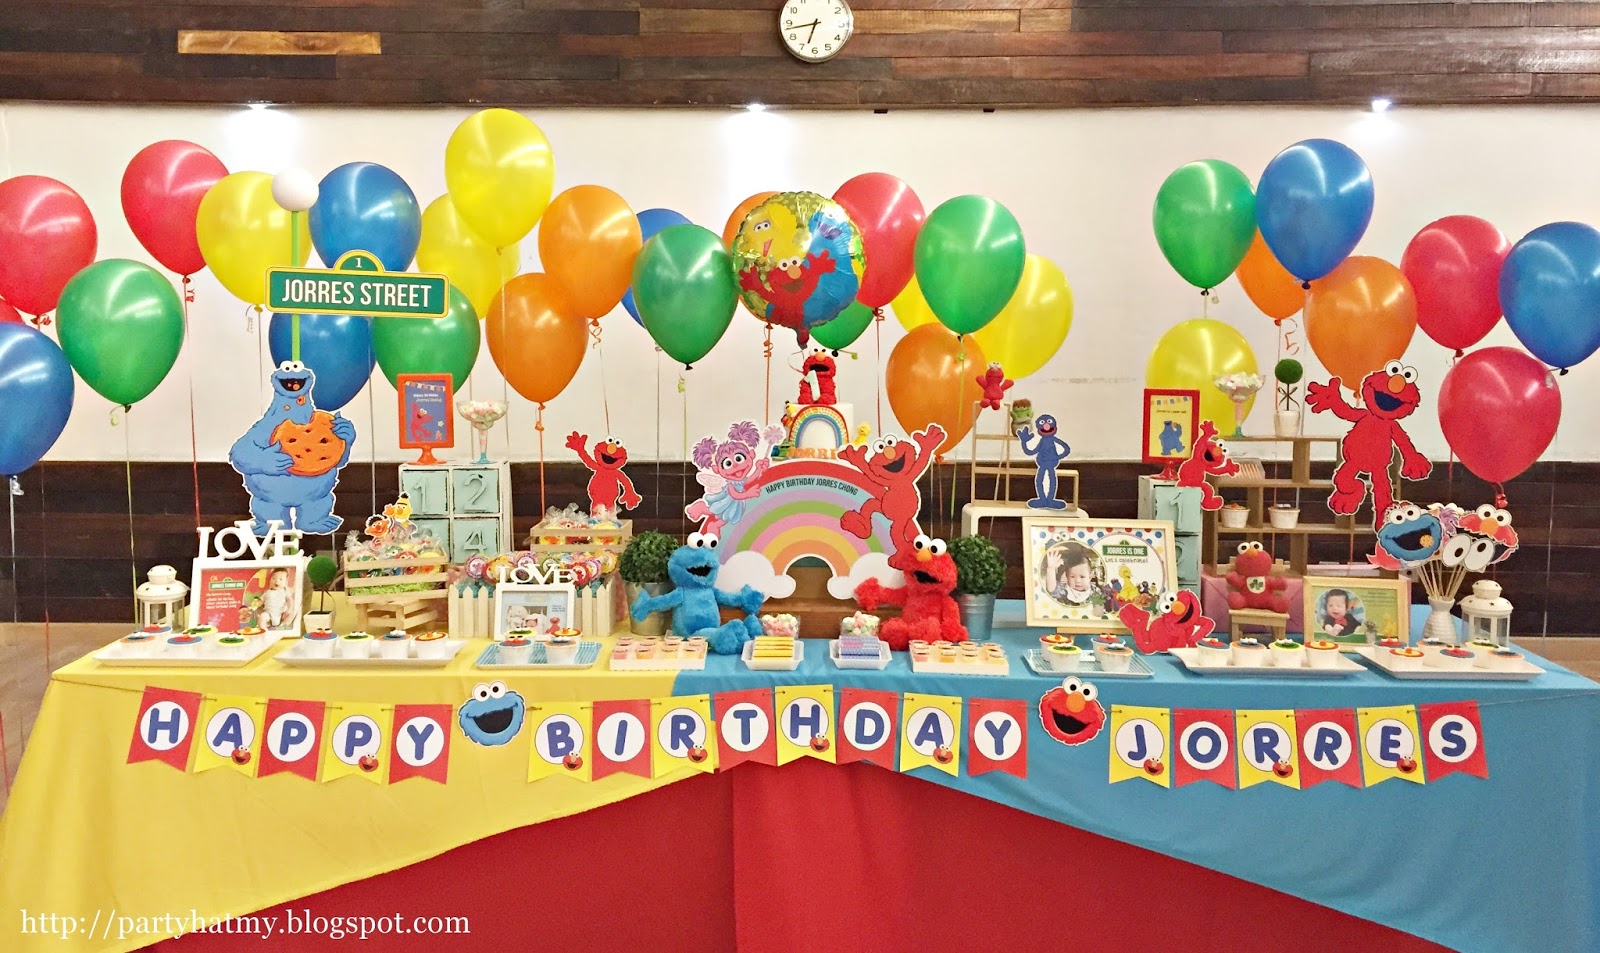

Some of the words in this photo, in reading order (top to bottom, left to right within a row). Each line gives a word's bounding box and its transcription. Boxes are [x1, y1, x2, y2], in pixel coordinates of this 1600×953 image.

[786, 19, 793, 27] 9
[789, 33, 797, 41] 8
[799, 43, 805, 51] 7
[824, 43, 832, 51] 5
[355, 257, 363, 269] 1
[281, 278, 355, 305] JORRES
[360, 282, 432, 308] STREET
[803, 369, 821, 402] 1
[413, 477, 428, 512] 1
[464, 473, 488, 512] 2
[765, 480, 785, 495] HAPPY
[785, 477, 815, 488] BIRTHDAY
[815, 477, 838, 490] JORRES
[837, 481, 859, 496] CHONG
[1169, 492, 1184, 531] 1
[196, 519, 305, 560] LOVE
[463, 526, 488, 558] 4
[1127, 547, 1133, 555] IS
[1134, 547, 1145, 555] ONE
[498, 563, 577, 585] LOVE
[147, 707, 435, 761] HAPPY
[546, 703, 1012, 758] BIRTHDAY
[1127, 721, 1466, 766] JORRES
